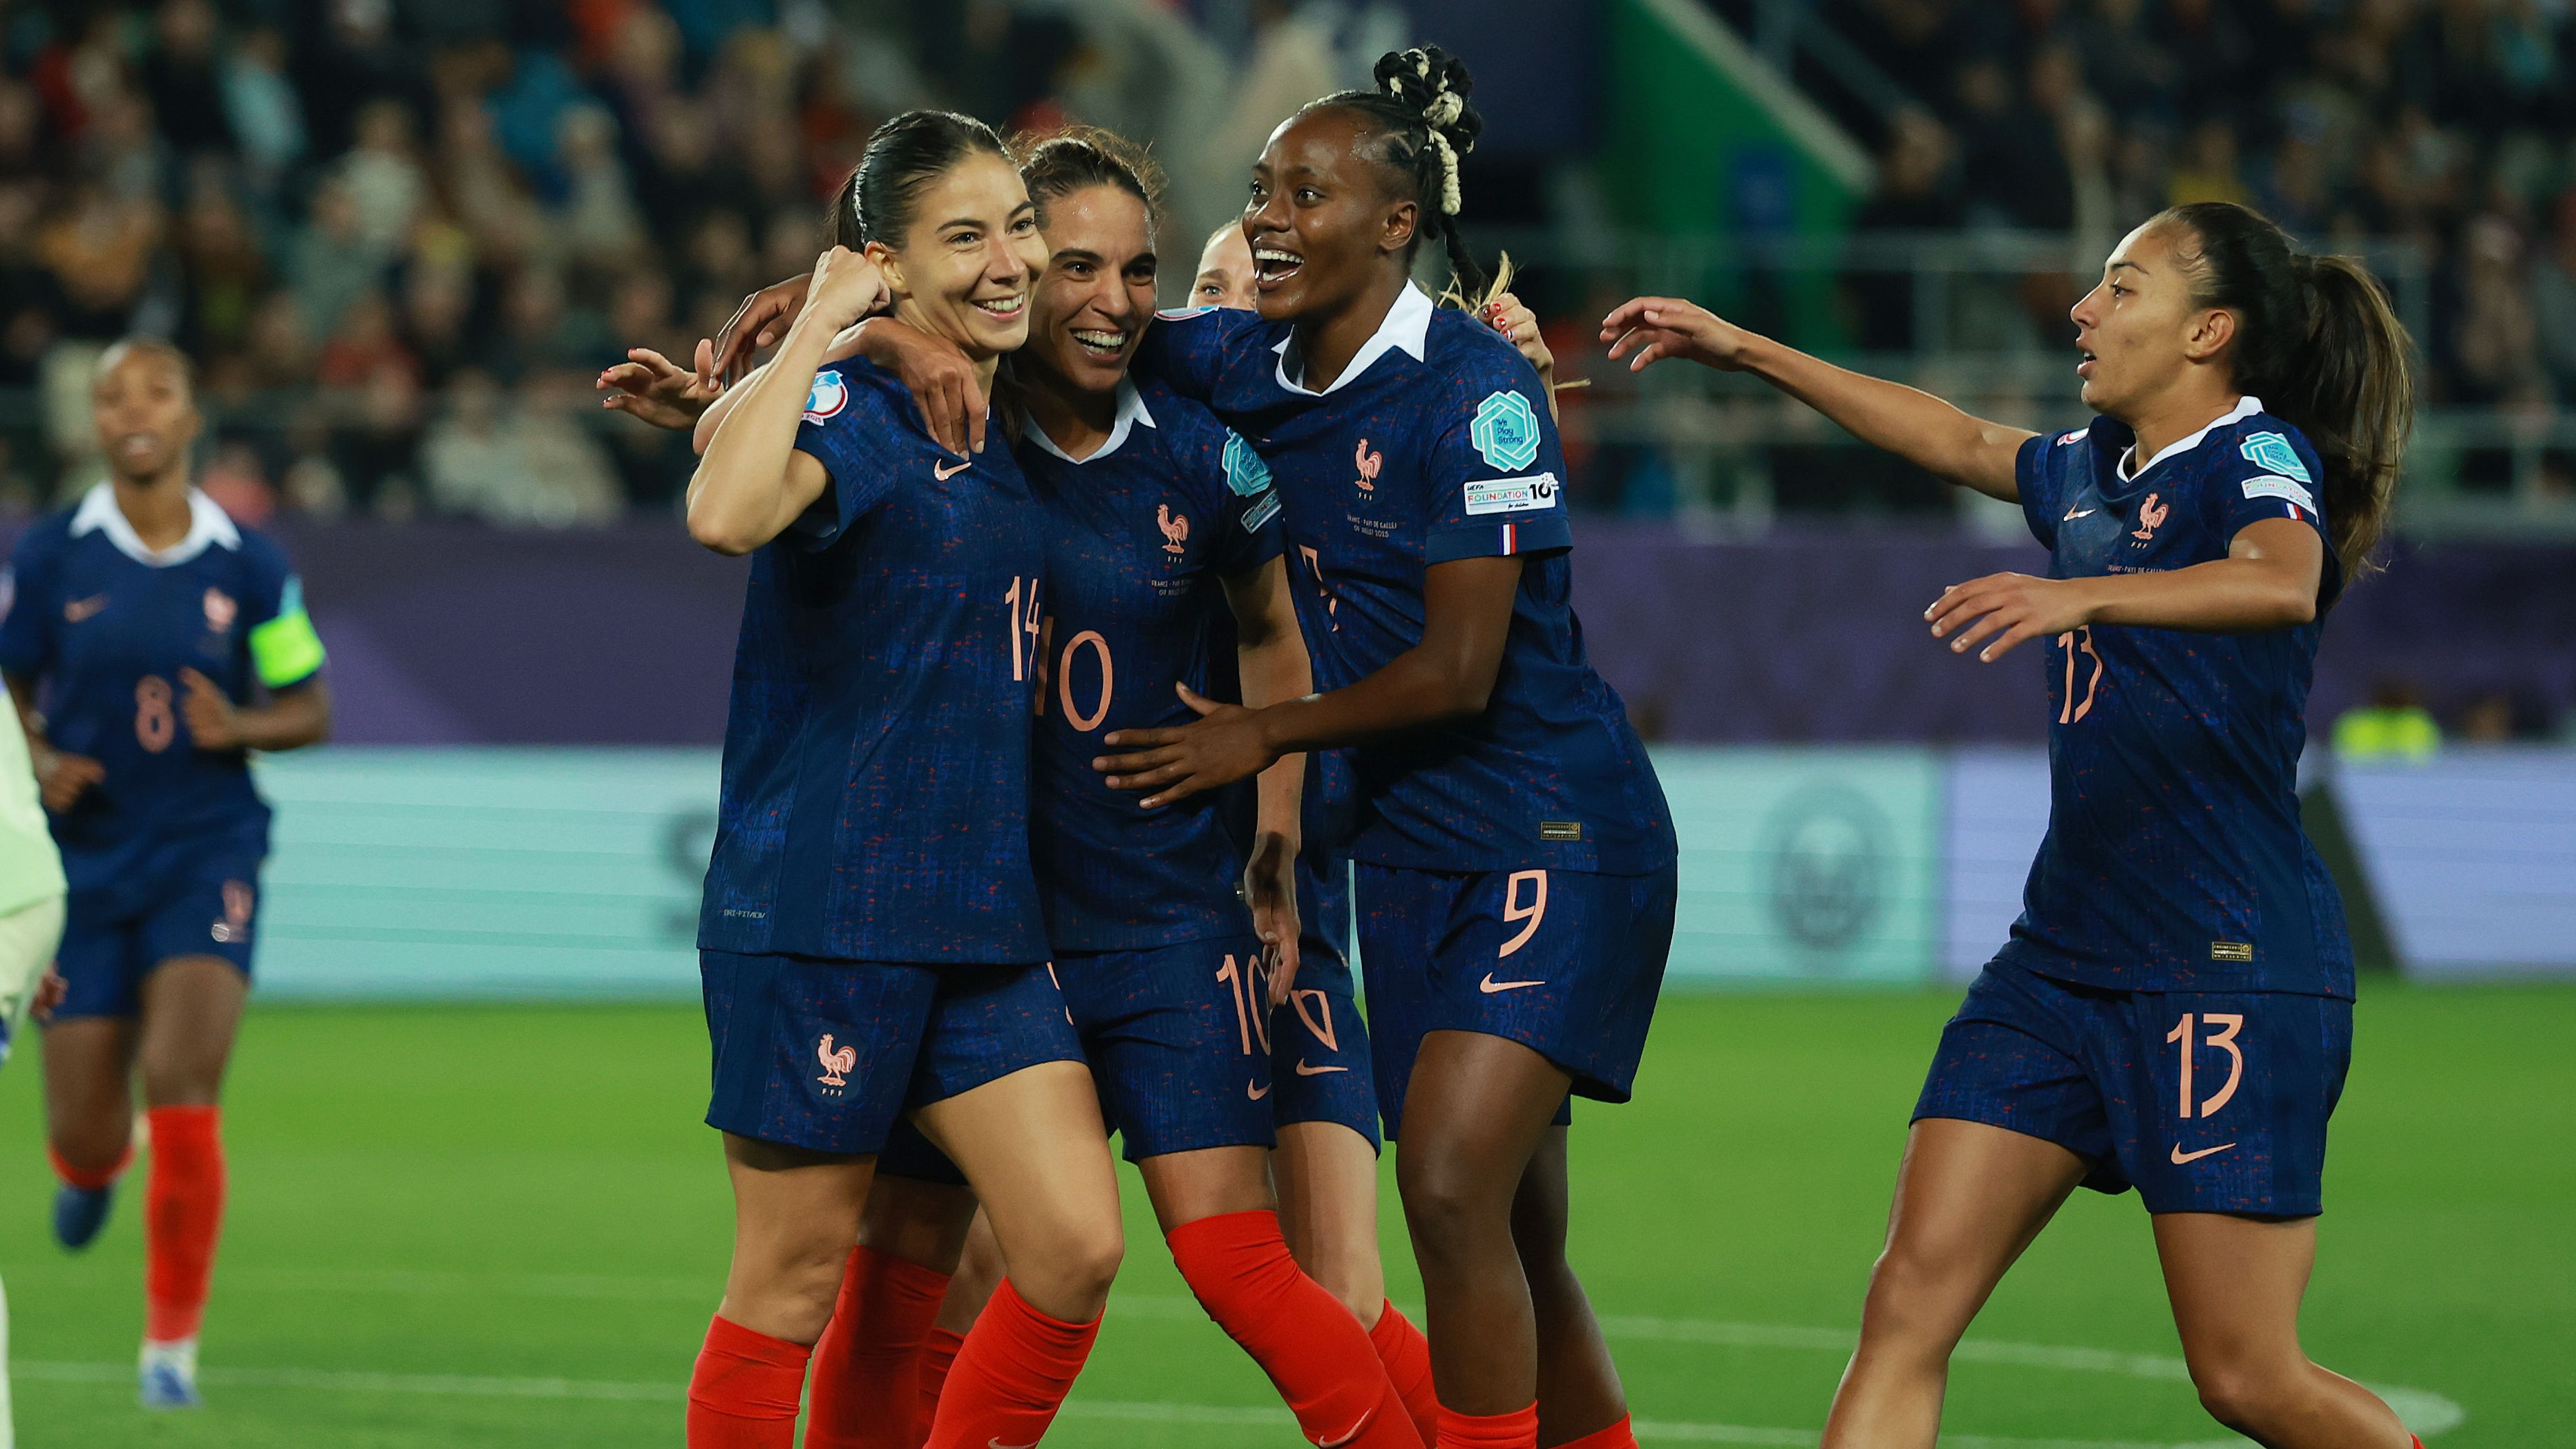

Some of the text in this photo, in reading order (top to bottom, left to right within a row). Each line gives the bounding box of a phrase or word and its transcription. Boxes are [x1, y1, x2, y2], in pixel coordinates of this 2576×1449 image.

[1498, 436, 1523, 445] Strong
[1374, 529, 1389, 538] 2025
[1468, 491, 1528, 502] FOUNDATION
[1529, 484, 1551, 499] 10
[1005, 576, 1039, 681] 14
[134, 674, 175, 753] 8
[1034, 616, 1113, 732] 10
[2058, 624, 2103, 724] 13
[1498, 869, 1547, 958] 9
[2166, 1013, 2243, 1119] 13
